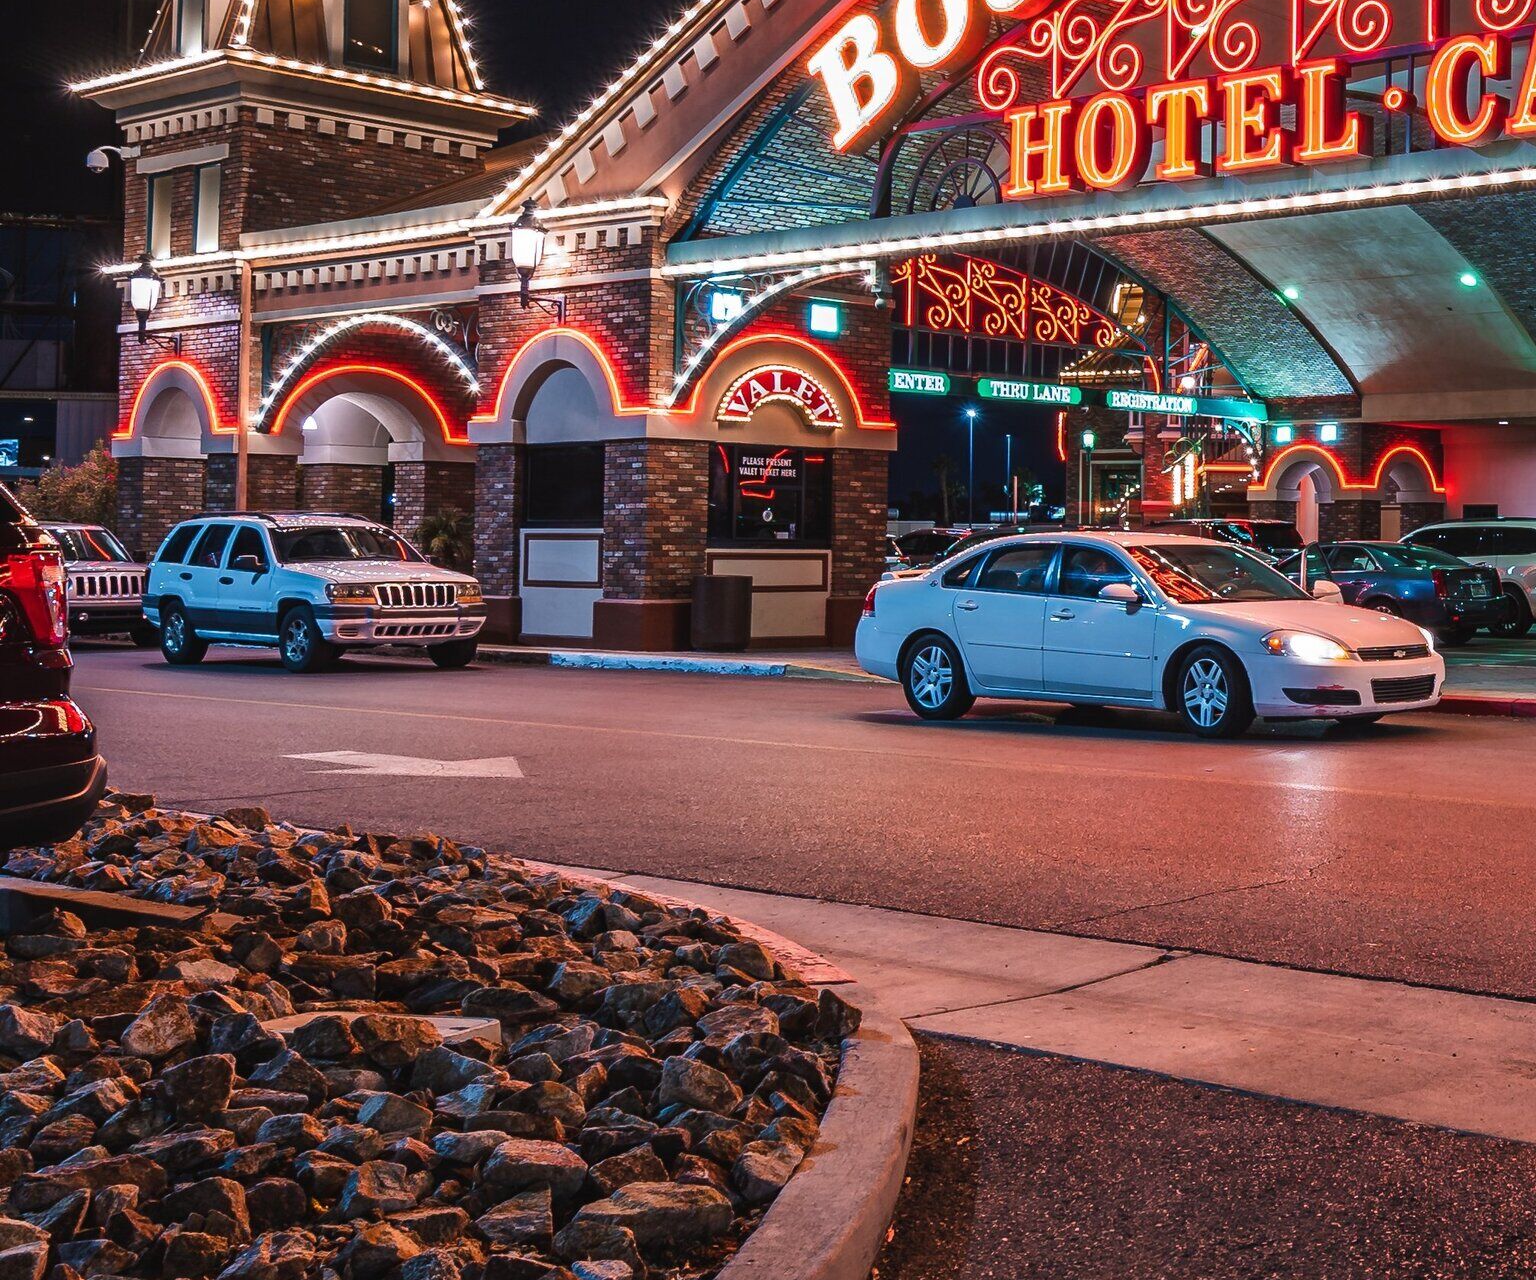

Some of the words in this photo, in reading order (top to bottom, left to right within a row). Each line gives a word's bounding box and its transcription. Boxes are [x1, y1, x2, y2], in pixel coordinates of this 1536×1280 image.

[1002, 57, 1361, 201] HOTEL
[893, 373, 945, 391] ENTER
[990, 381, 1029, 399] THRU
[1033, 384, 1072, 403] LANE
[727, 371, 834, 420] VALET
[1111, 391, 1194, 413] REGISTRATION
[739, 466, 758, 476] VALET
[781, 469, 797, 478] HERE
[742, 456, 765, 466] PLEASE
[766, 458, 792, 467] PRESENT
